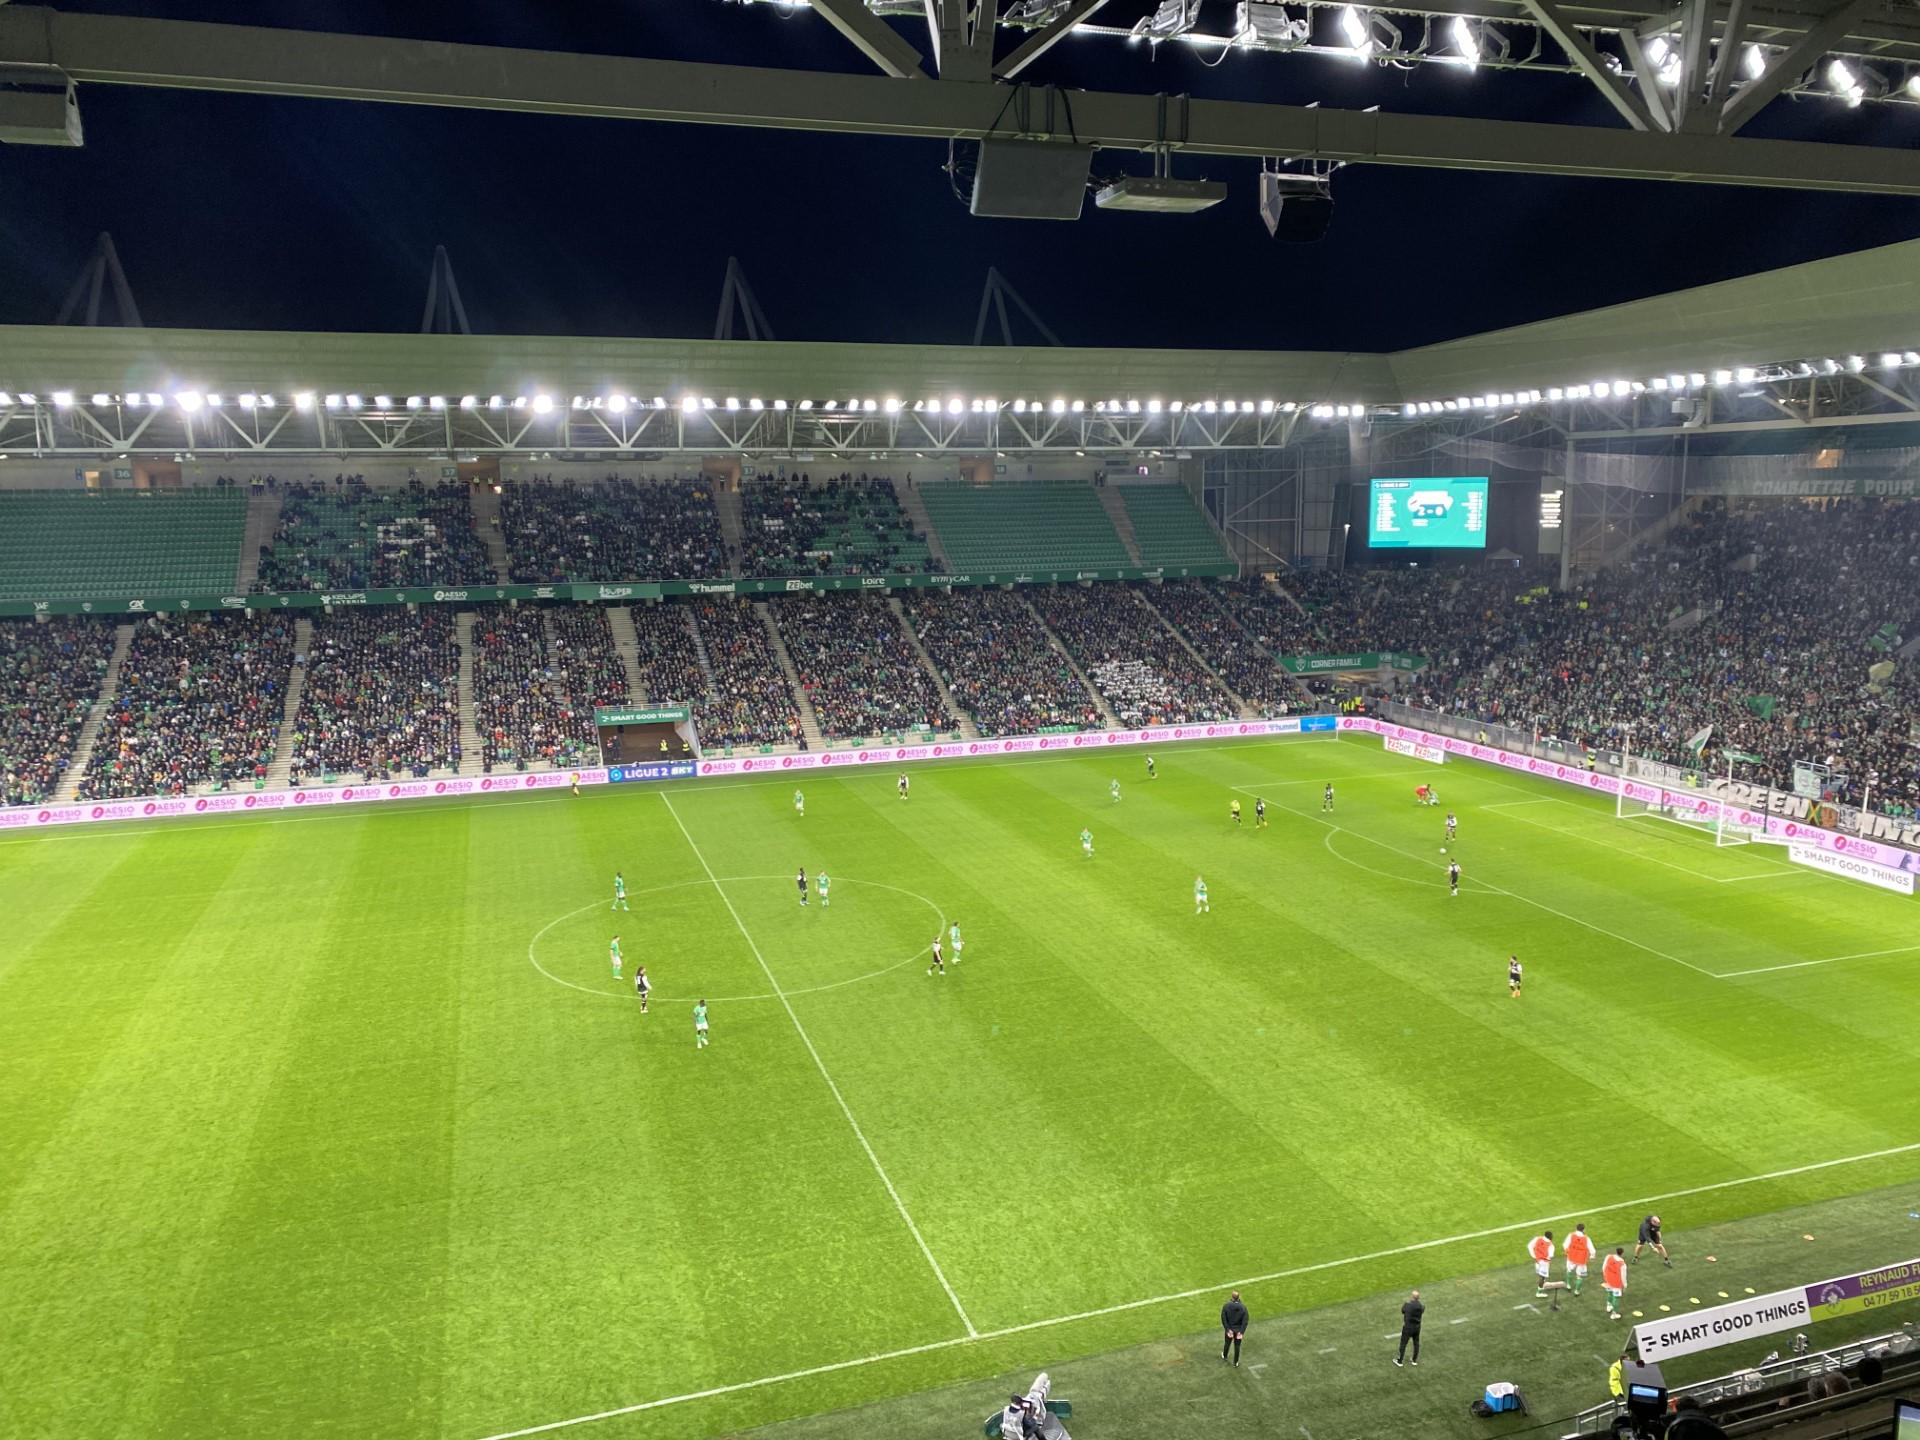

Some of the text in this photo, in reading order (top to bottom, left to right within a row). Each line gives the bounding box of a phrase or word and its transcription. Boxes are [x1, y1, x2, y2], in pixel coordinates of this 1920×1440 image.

[1752, 479, 1915, 496] COMBATTRE POUR
[701, 583, 736, 592] hummel
[1311, 577, 1362, 588] CORNER FAMILLE
[624, 767, 659, 779] LIGUE
[661, 767, 669, 777] 2
[1708, 777, 1808, 819] GREEN
[1804, 850, 1910, 886] SMART GOOD THINGS
[1859, 1266, 1910, 1288] REYNAUD
[1863, 1297, 1875, 1307] 04
[1877, 1293, 1887, 1305] 77
[1889, 1290, 1899, 1302] 59
[1660, 1301, 1806, 1348] SMART GOOD THINGS
